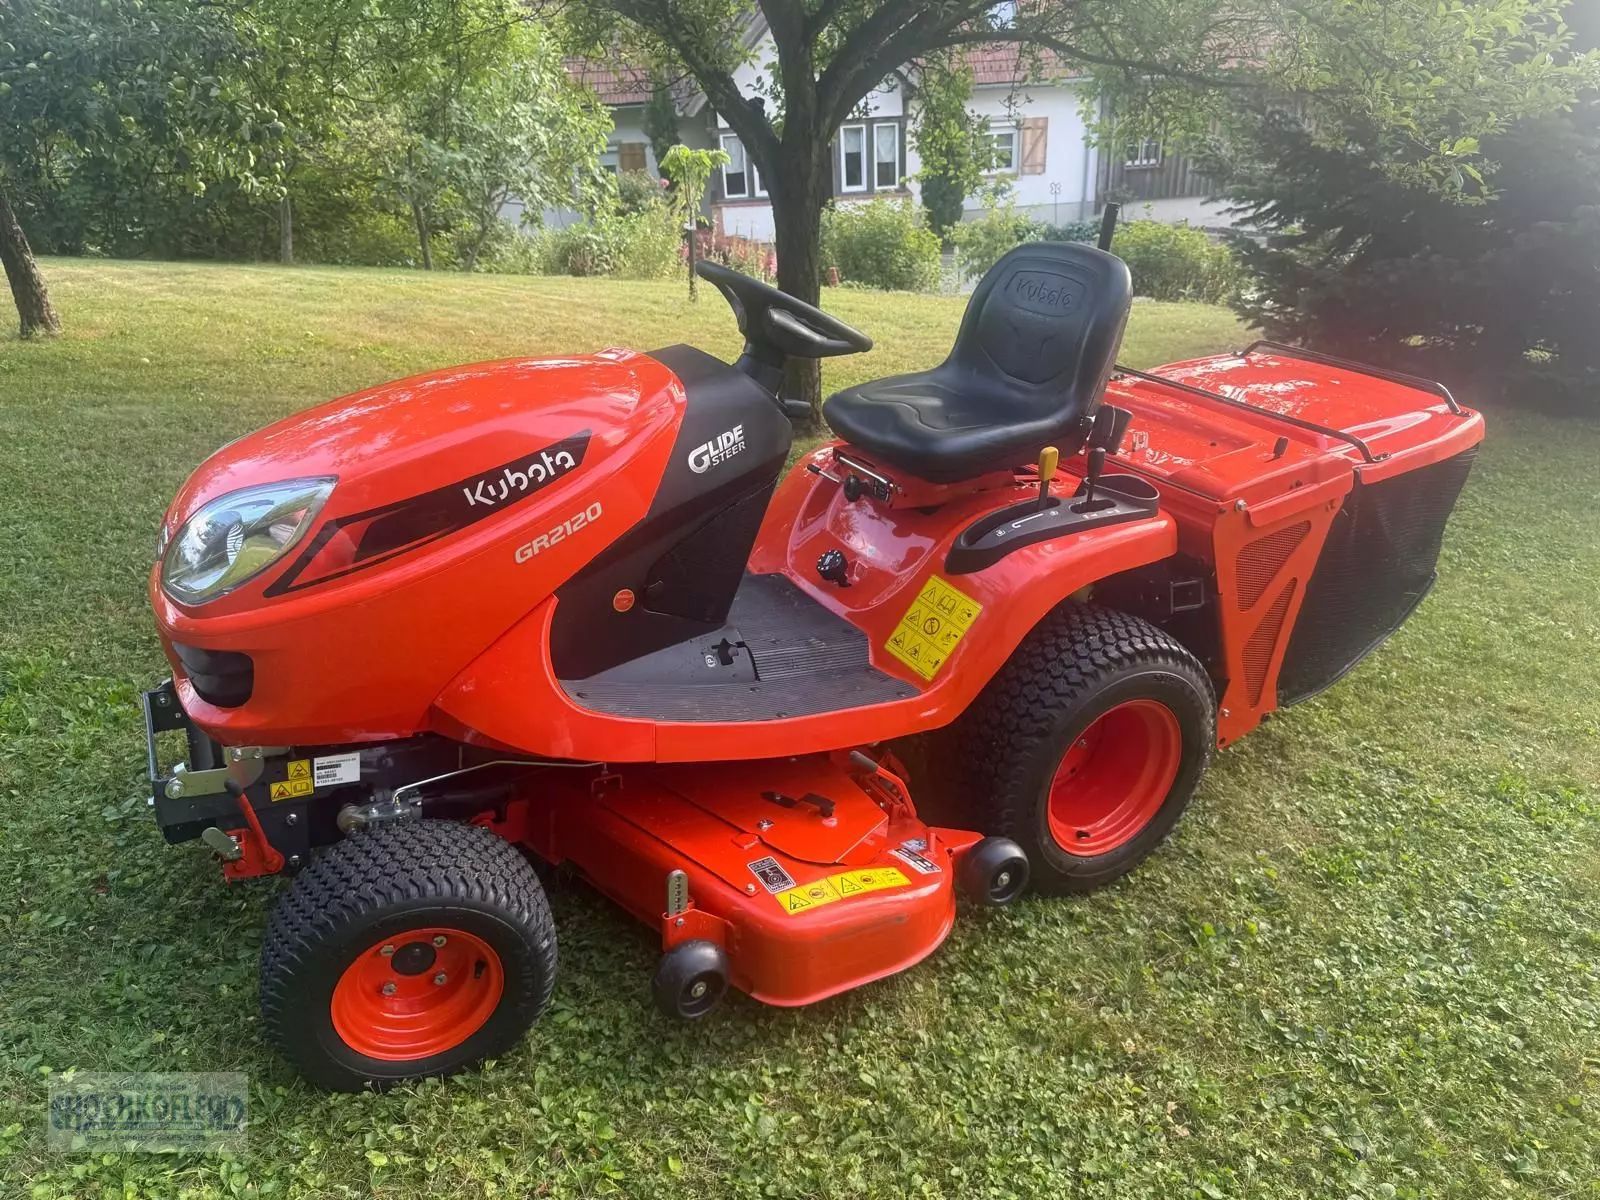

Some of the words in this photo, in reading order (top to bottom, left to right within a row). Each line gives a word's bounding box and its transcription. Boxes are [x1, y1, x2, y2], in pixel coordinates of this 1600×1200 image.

[1016, 279, 1073, 307] Kubota
[687, 424, 744, 474] GLIDE
[711, 441, 747, 467] STEER
[463, 450, 576, 507] Kubota
[514, 501, 603, 565] GR2120
